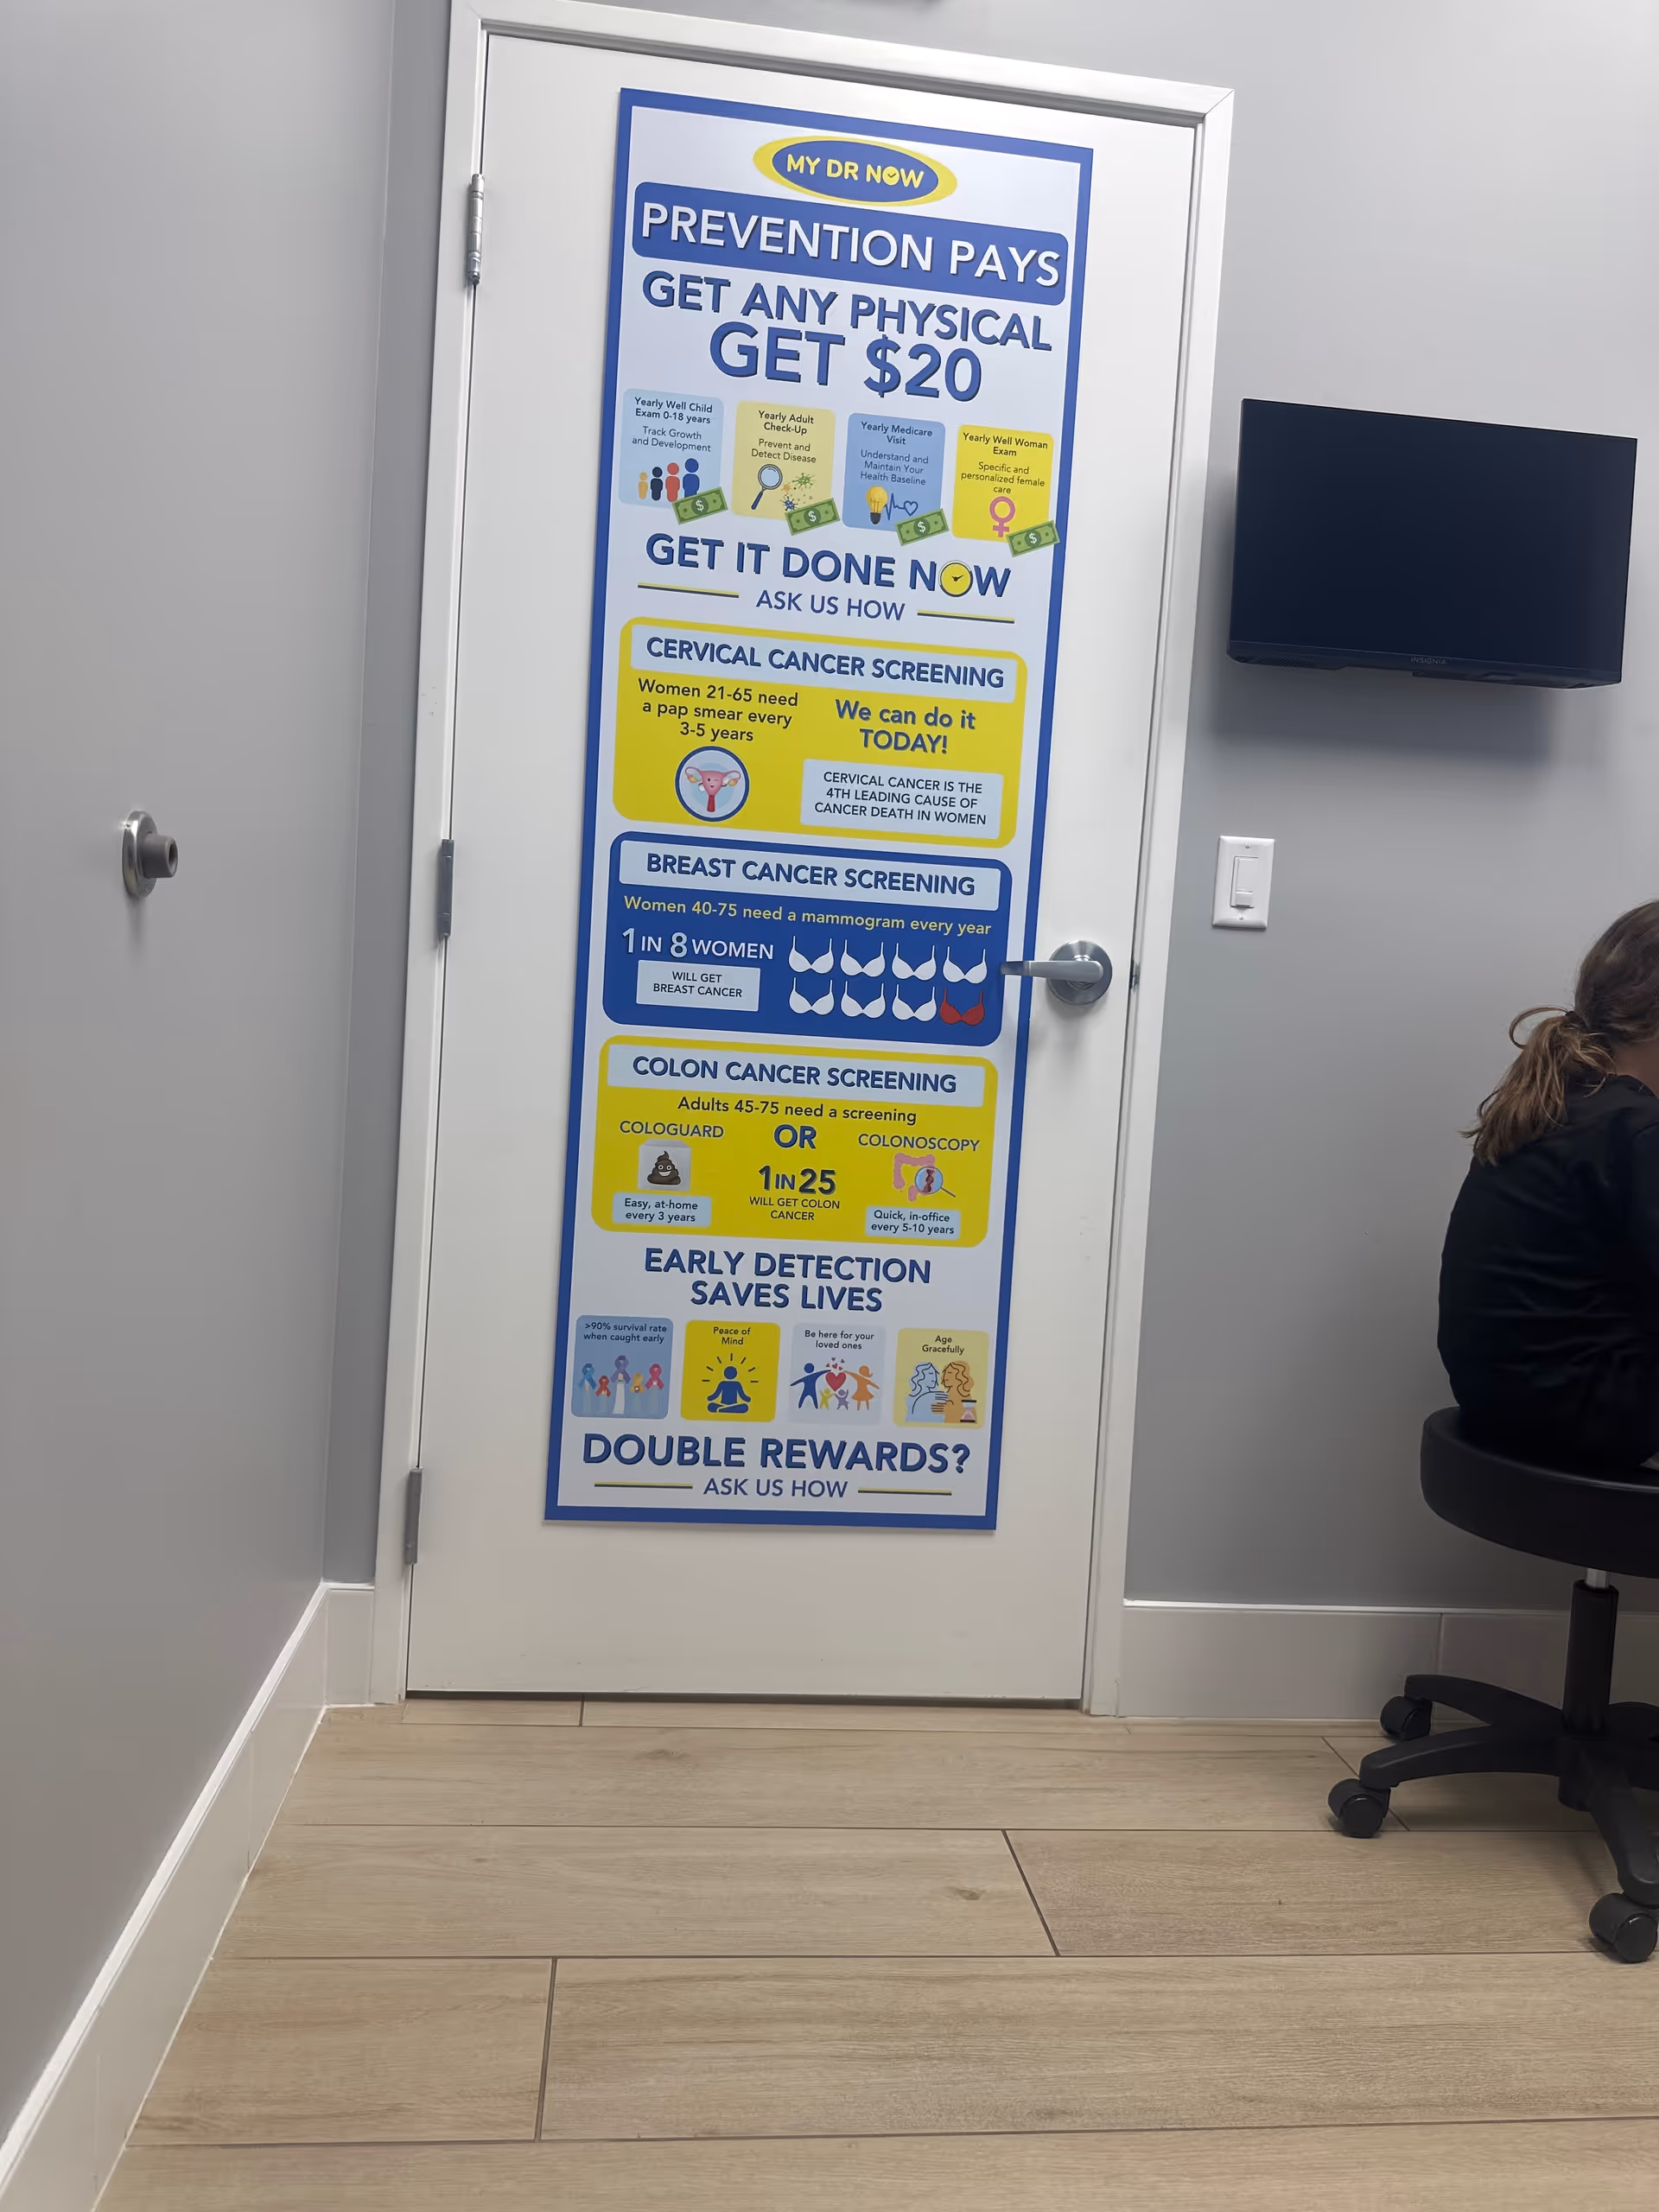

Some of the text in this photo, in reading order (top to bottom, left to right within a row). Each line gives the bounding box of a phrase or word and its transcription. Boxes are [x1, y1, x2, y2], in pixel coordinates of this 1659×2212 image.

[787, 154, 923, 188] MY DR NOW
[642, 202, 1059, 287] PREVENTION PAYS
[642, 270, 1052, 351] GET ANY PHYSICAL
[710, 321, 982, 402] GET $20
[634, 397, 713, 413] Yearly Well Child
[635, 408, 710, 424] Exam 0-18 years
[758, 410, 814, 424] Yearly Adult
[643, 426, 702, 440] Track Growth
[764, 422, 807, 435] Check-Up
[861, 422, 932, 436] Yearly Medicare
[632, 435, 711, 452] and Development
[759, 438, 810, 451] Prevent and
[887, 435, 906, 445] Visit
[963, 433, 1048, 448] Yearly Well Woman
[751, 448, 817, 462] Detect Disease
[861, 449, 929, 463] Understand and
[993, 448, 1017, 456] Exam
[864, 460, 924, 474] Maintain Your
[978, 462, 1029, 475] Specific and
[861, 470, 925, 485] Health Baseline
[961, 472, 1045, 486] personalized female
[994, 486, 1012, 494] care
[645, 533, 1011, 597] GET IT DONE NOW
[756, 589, 905, 620] ASK US HOW
[646, 637, 1004, 688] CERVICAL CANCER SCREENING
[639, 677, 798, 707] Women 21-65 need
[643, 702, 792, 729] a pap smear every
[836, 698, 976, 729] We can do it
[679, 721, 753, 741] 3-5 years
[860, 728, 948, 754] TODAY!
[823, 772, 982, 794] CERVICAL CANCER IS THE
[826, 788, 977, 808] 4TH LEADING CAUSE OF
[815, 803, 986, 824] CANCER DEATH IN WOMEN
[646, 853, 975, 896] BREAST CANCER SCREENING
[624, 896, 991, 936] Women 40-75 need a mammogram every year
[622, 928, 773, 959] 1 IN 8 WOMEN
[672, 971, 722, 983] WILL GET
[653, 983, 742, 997] BREAST CANCER
[632, 1056, 957, 1093] COLON CANCER SCREENING
[677, 1096, 917, 1125] Adults 45-75 need a screening
[620, 1121, 724, 1139] COLOGUARD
[773, 1124, 817, 1149] OR
[858, 1133, 980, 1152] COLONOSCOPY
[625, 1198, 697, 1211] Easy, at-home
[749, 1197, 840, 1210] WILL GET COLON
[626, 1211, 696, 1224] every 3 years
[770, 1211, 814, 1221] CANCER
[874, 1210, 950, 1222] Quick, in-office
[871, 1222, 954, 1236] every 5-10 years
[644, 1248, 931, 1283] EARLY DETECTION
[690, 1281, 882, 1312] SAVES LIVES
[585, 1322, 667, 1333] >90% survival rate
[714, 1325, 752, 1335] Peace of
[610, 1332, 640, 1343] caught
[643, 1333, 664, 1344] early
[721, 1336, 743, 1344] Mind
[805, 1330, 817, 1338] Be
[819, 1331, 838, 1339] here
[855, 1332, 874, 1342] your
[935, 1335, 952, 1345] Age
[816, 1340, 838, 1349] loved
[922, 1344, 964, 1355] Gracefully
[583, 1433, 970, 1473] DOUBLE REWARDS?
[703, 1478, 848, 1497] ASK US HOW
